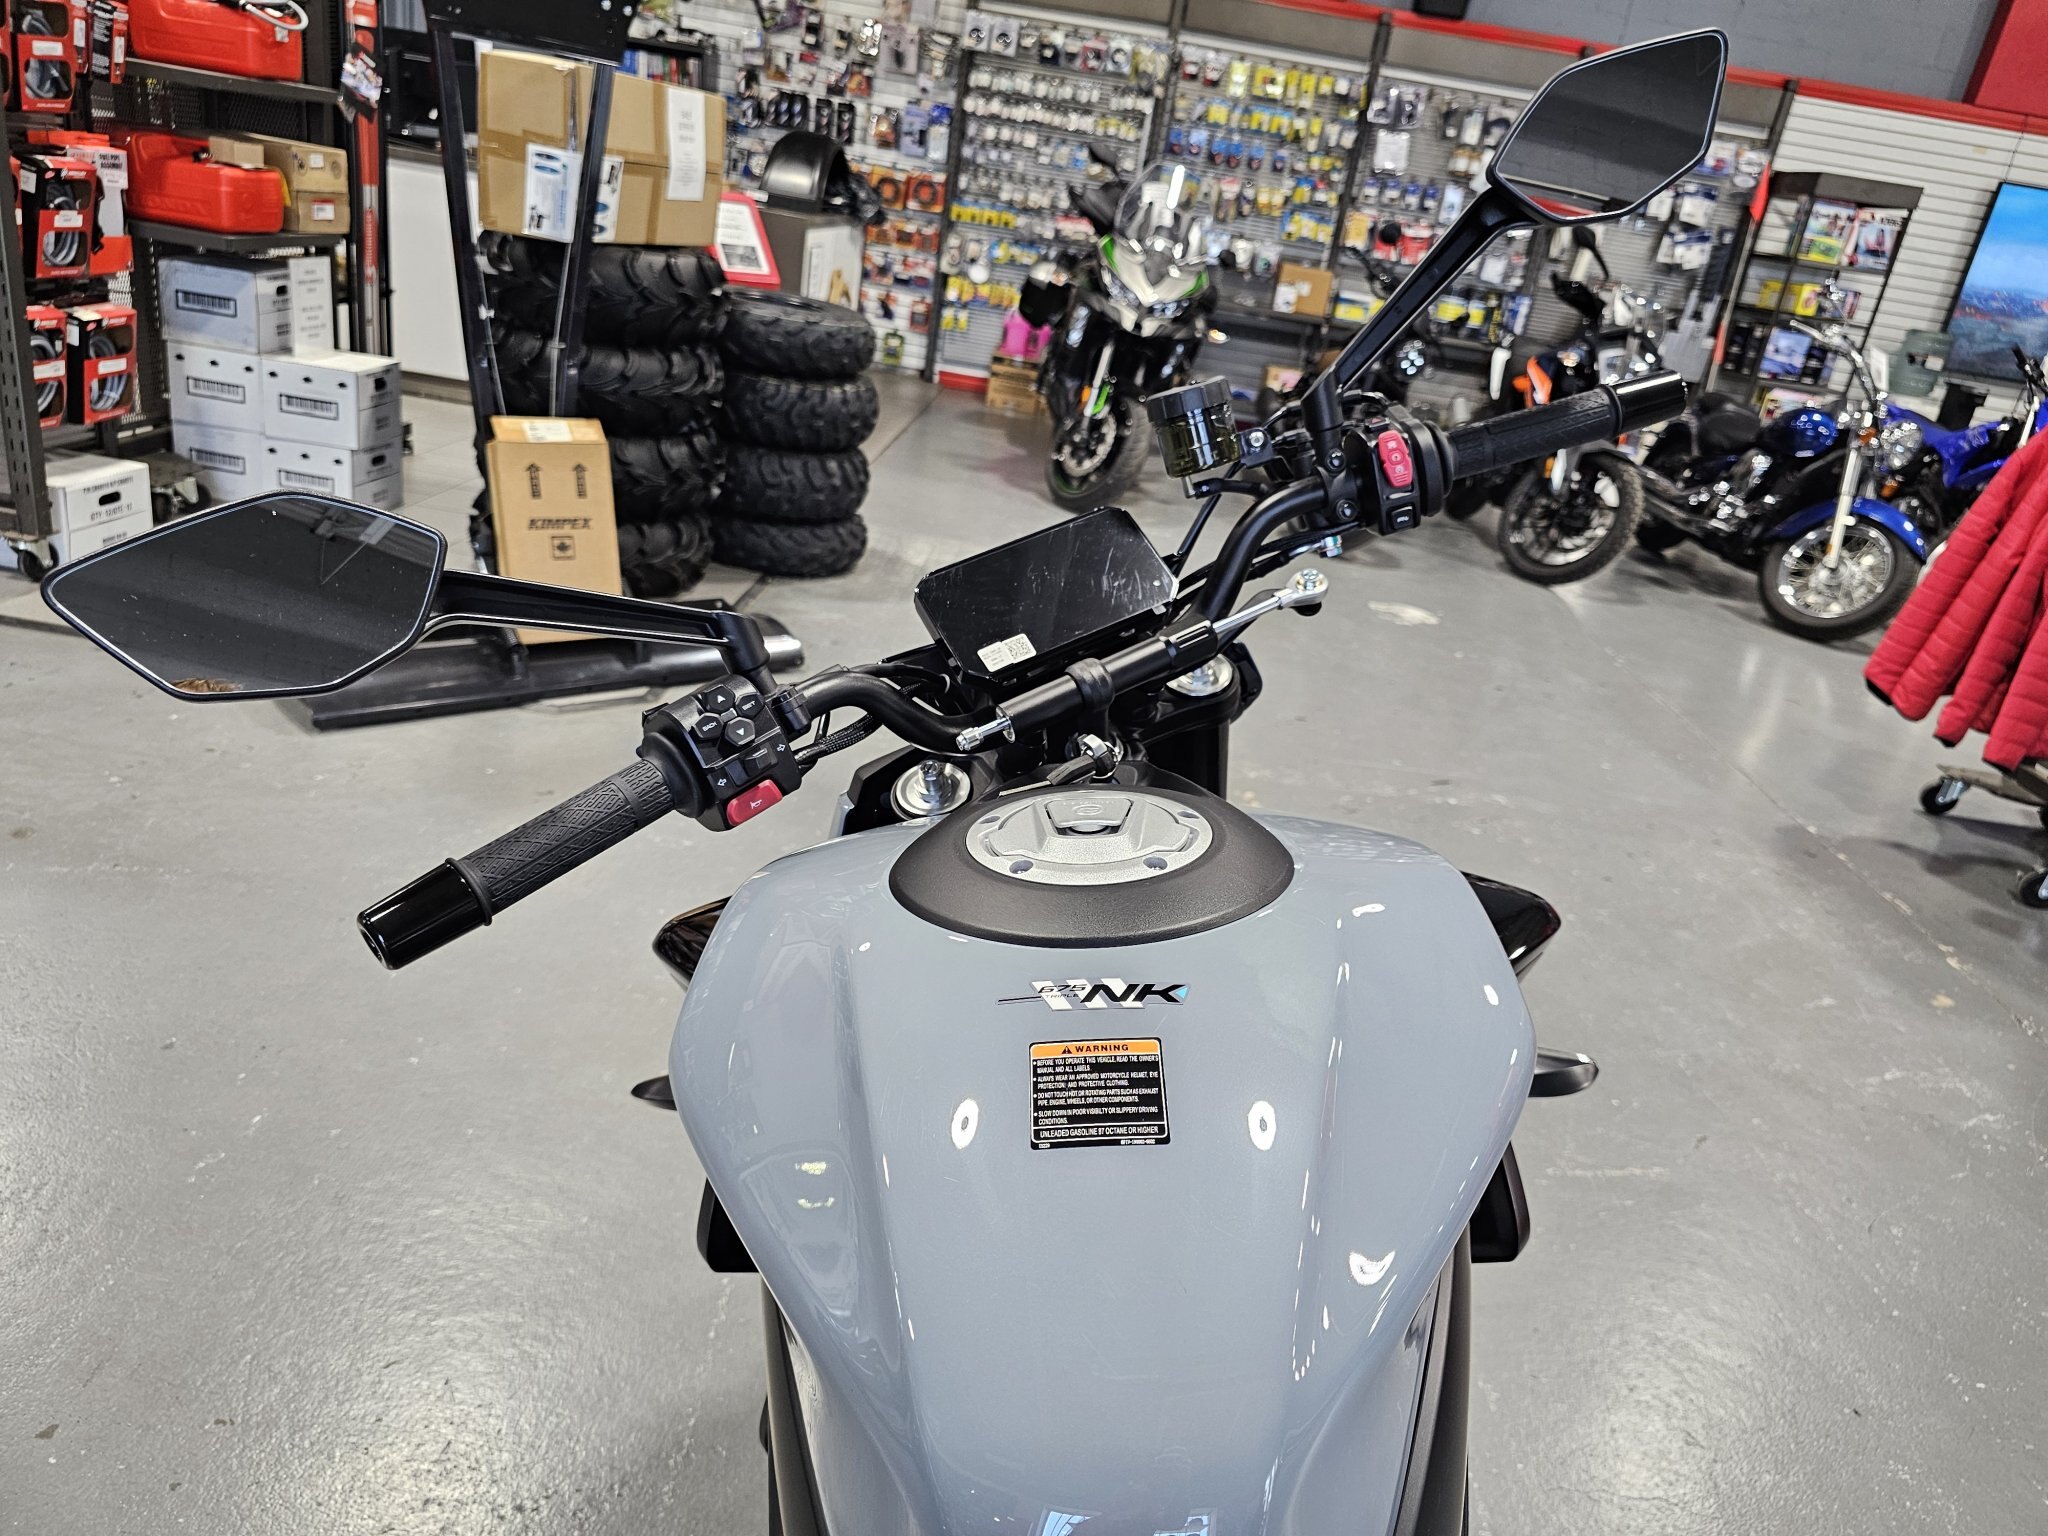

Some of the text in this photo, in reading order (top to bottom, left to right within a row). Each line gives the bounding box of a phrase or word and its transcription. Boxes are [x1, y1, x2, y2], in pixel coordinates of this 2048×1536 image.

[528, 518, 594, 531] KIMPEX
[1038, 984, 1185, 1003] 675 NK
[1075, 1044, 1129, 1053] WARNING
[1037, 1058, 1054, 1066] BEFORE
[1065, 1057, 1085, 1065] OPERATE
[1116, 1055, 1128, 1063] READ
[1055, 1074, 1068, 1082] WEAR
[1139, 1087, 1159, 1095] EXHAUST
[1067, 1097, 1086, 1105] WHEELS,
[1052, 1109, 1066, 1117] DOWN
[1115, 1106, 1138, 1114] SLIPPERY
[1038, 1117, 1068, 1125] CONDITIONS.
[1040, 1129, 1069, 1138] UNLEADED
[1069, 1127, 1098, 1136] GASOLINE
[1105, 1126, 1128, 1135] OCTANE
[1127, 1126, 1137, 1134] OR
[1137, 1126, 1159, 1134] HIGHER
